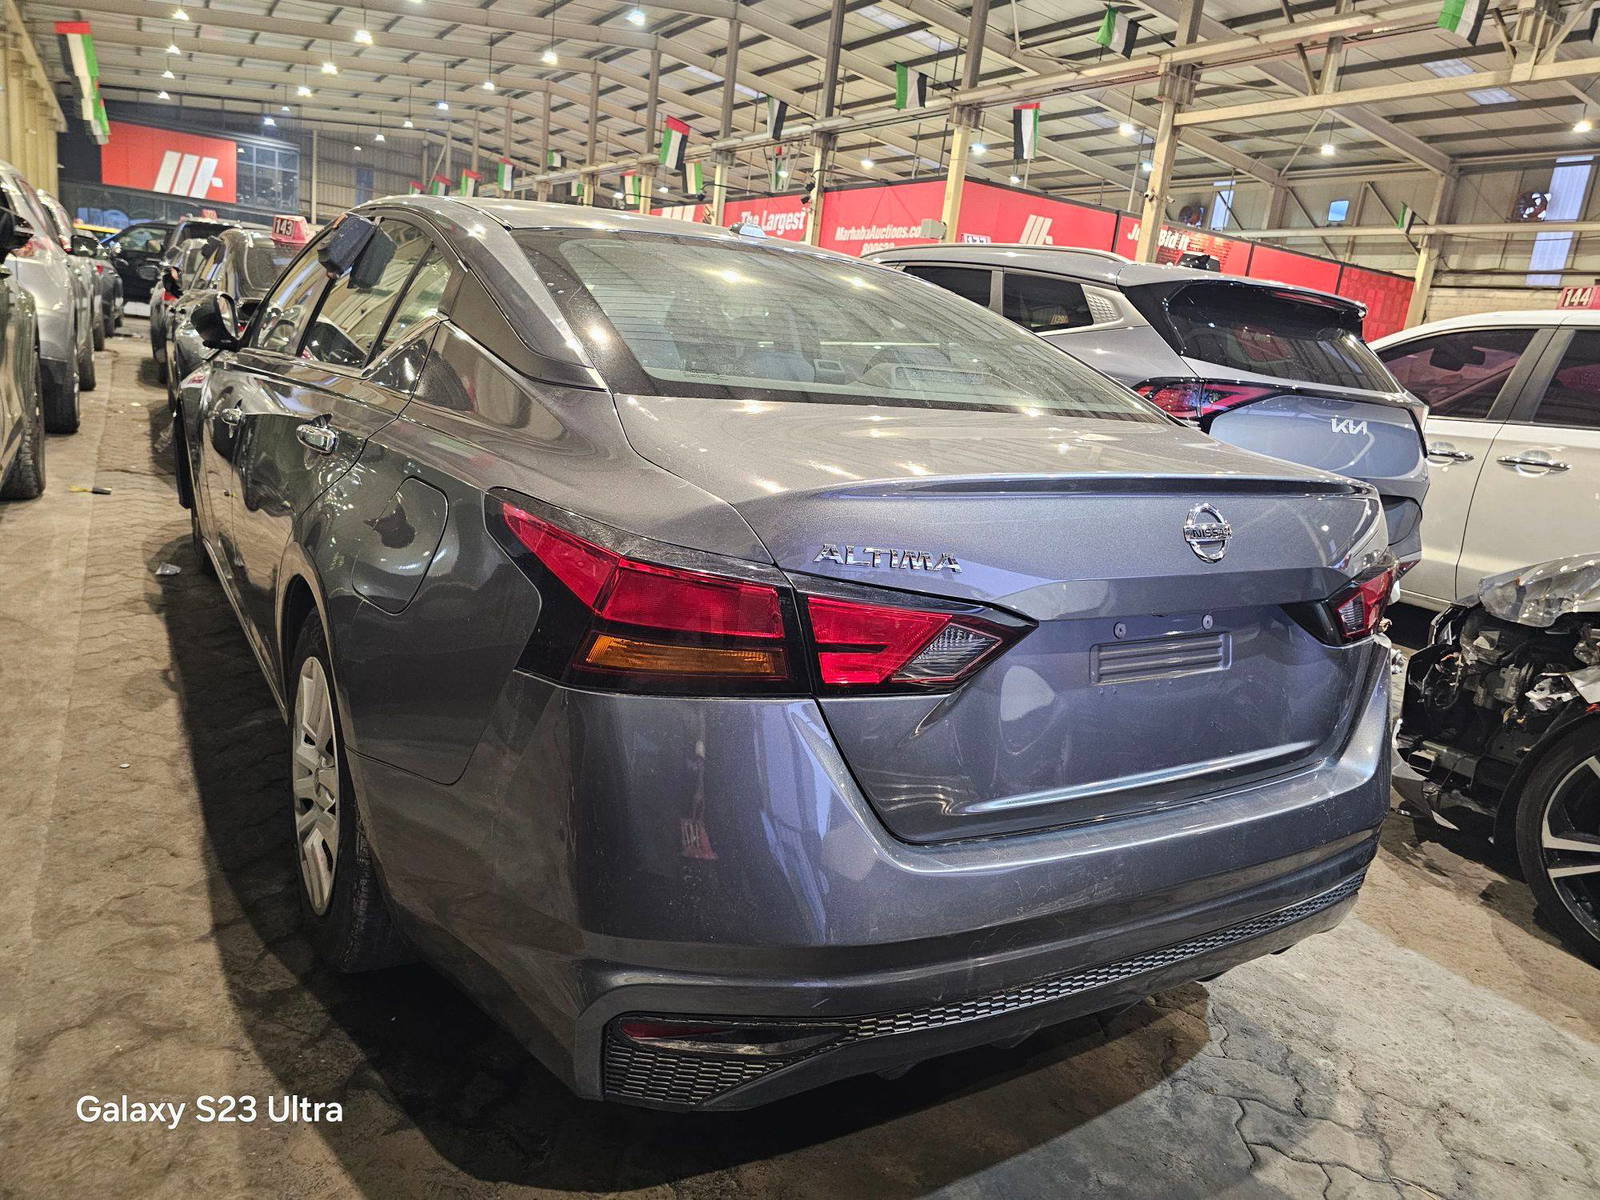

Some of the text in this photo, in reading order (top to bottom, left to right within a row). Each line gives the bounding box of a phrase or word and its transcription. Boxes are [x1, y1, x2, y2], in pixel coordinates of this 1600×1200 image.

[275, 219, 293, 236] 143
[761, 209, 806, 235] Largest
[835, 224, 923, 240] MarhabaAuctions.co
[1158, 229, 1179, 250] Bid
[1564, 287, 1592, 307] 144
[813, 543, 963, 573] ALTIMA
